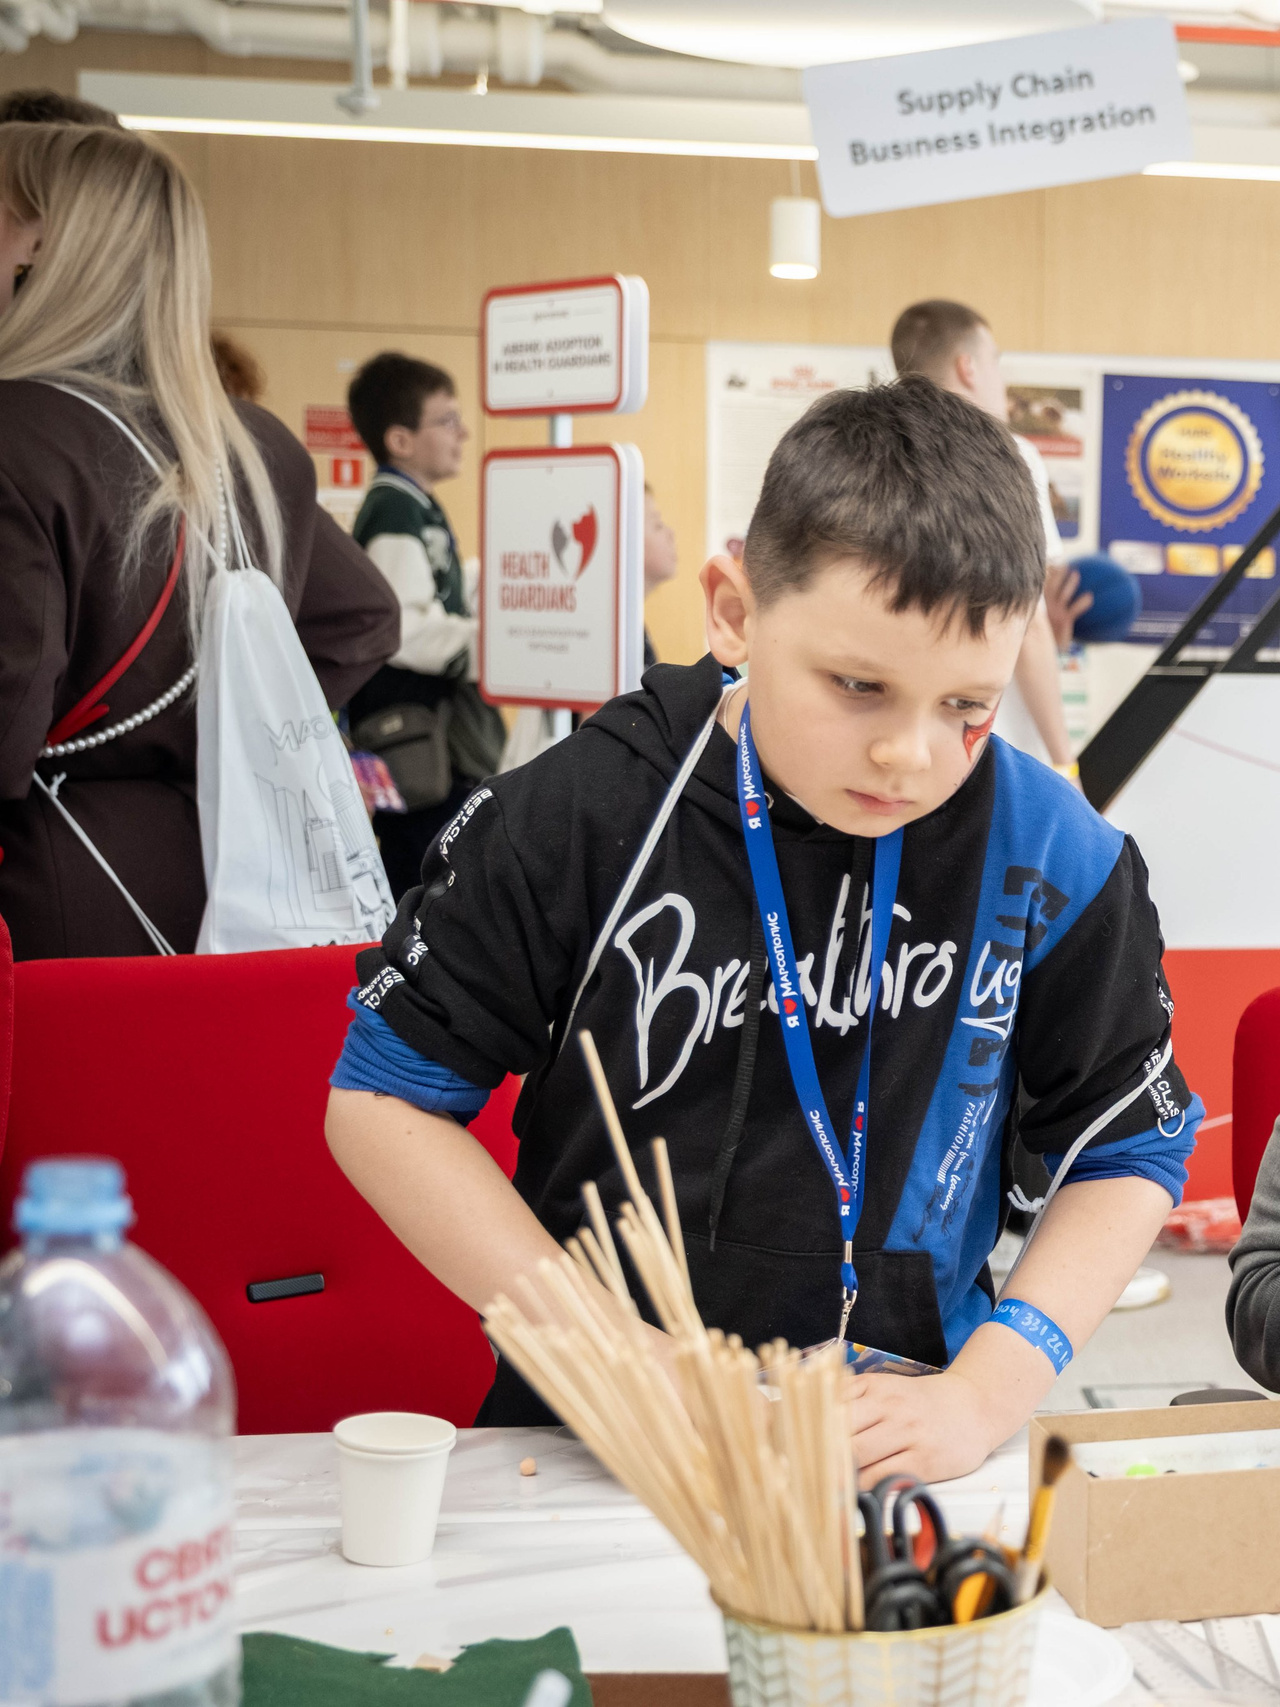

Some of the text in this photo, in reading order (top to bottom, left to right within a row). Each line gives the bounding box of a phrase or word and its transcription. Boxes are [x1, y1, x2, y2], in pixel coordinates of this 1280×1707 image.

[897, 67, 1095, 116] Supply Chain
[850, 103, 1157, 165] Business Integration
[500, 551, 551, 580] HEALTH
[499, 583, 577, 613] GUARDIANS
[462, 789, 493, 826] BEST
[748, 817, 762, 830] Я
[357, 975, 381, 1001] FASHIO
[379, 972, 405, 997] EST
[786, 1015, 800, 1028] Я
[857, 1101, 866, 1113] Я
[1157, 1080, 1180, 1117] CLAS
[951, 1101, 976, 1152] FASHION
[841, 1204, 851, 1217] Я
